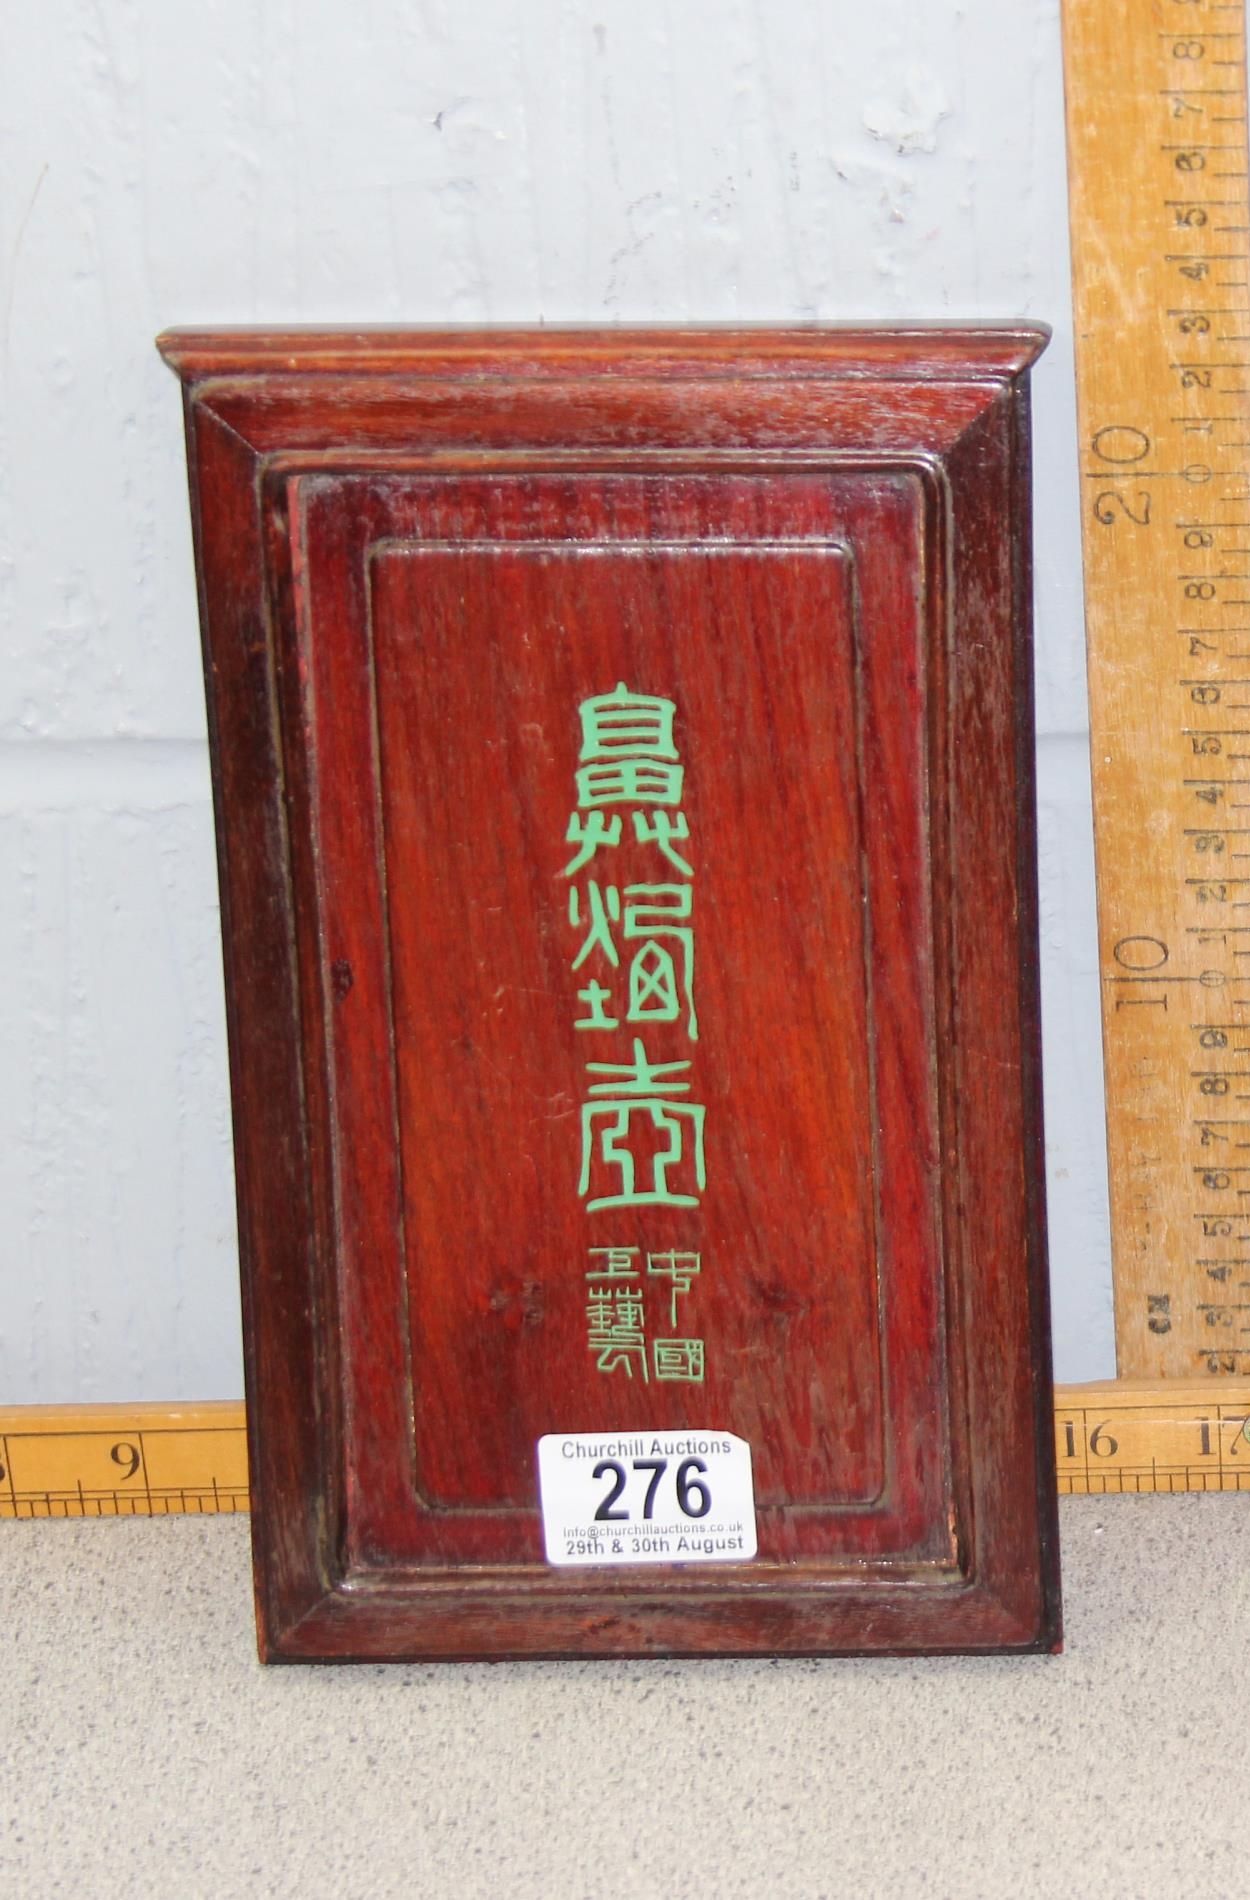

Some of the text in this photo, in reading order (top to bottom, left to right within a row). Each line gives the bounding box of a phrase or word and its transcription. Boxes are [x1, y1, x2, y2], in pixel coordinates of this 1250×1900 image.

[1172, 40, 1205, 60] 8
[1174, 98, 1203, 118] 7
[1176, 208, 1208, 228] 5
[1179, 262, 1209, 281] 4
[1179, 315, 1210, 334] 3
[1181, 370, 1211, 388] 2
[1184, 582, 1216, 600] 8
[1189, 637, 1218, 655] 7
[1192, 737, 1221, 756] 5
[1196, 787, 1224, 804] 4
[1113, 936, 1169, 1012] 10
[1200, 1078, 1229, 1096] 8
[1201, 1127, 1229, 1145] 7
[1203, 1220, 1232, 1236] 5
[1062, 1418, 1118, 1458] 16
[562, 1437, 731, 1459] Churchill Auctions
[111, 1442, 140, 1481] 9
[592, 1456, 712, 1521] 276
[566, 1535, 744, 1555] 29th & 30th August
